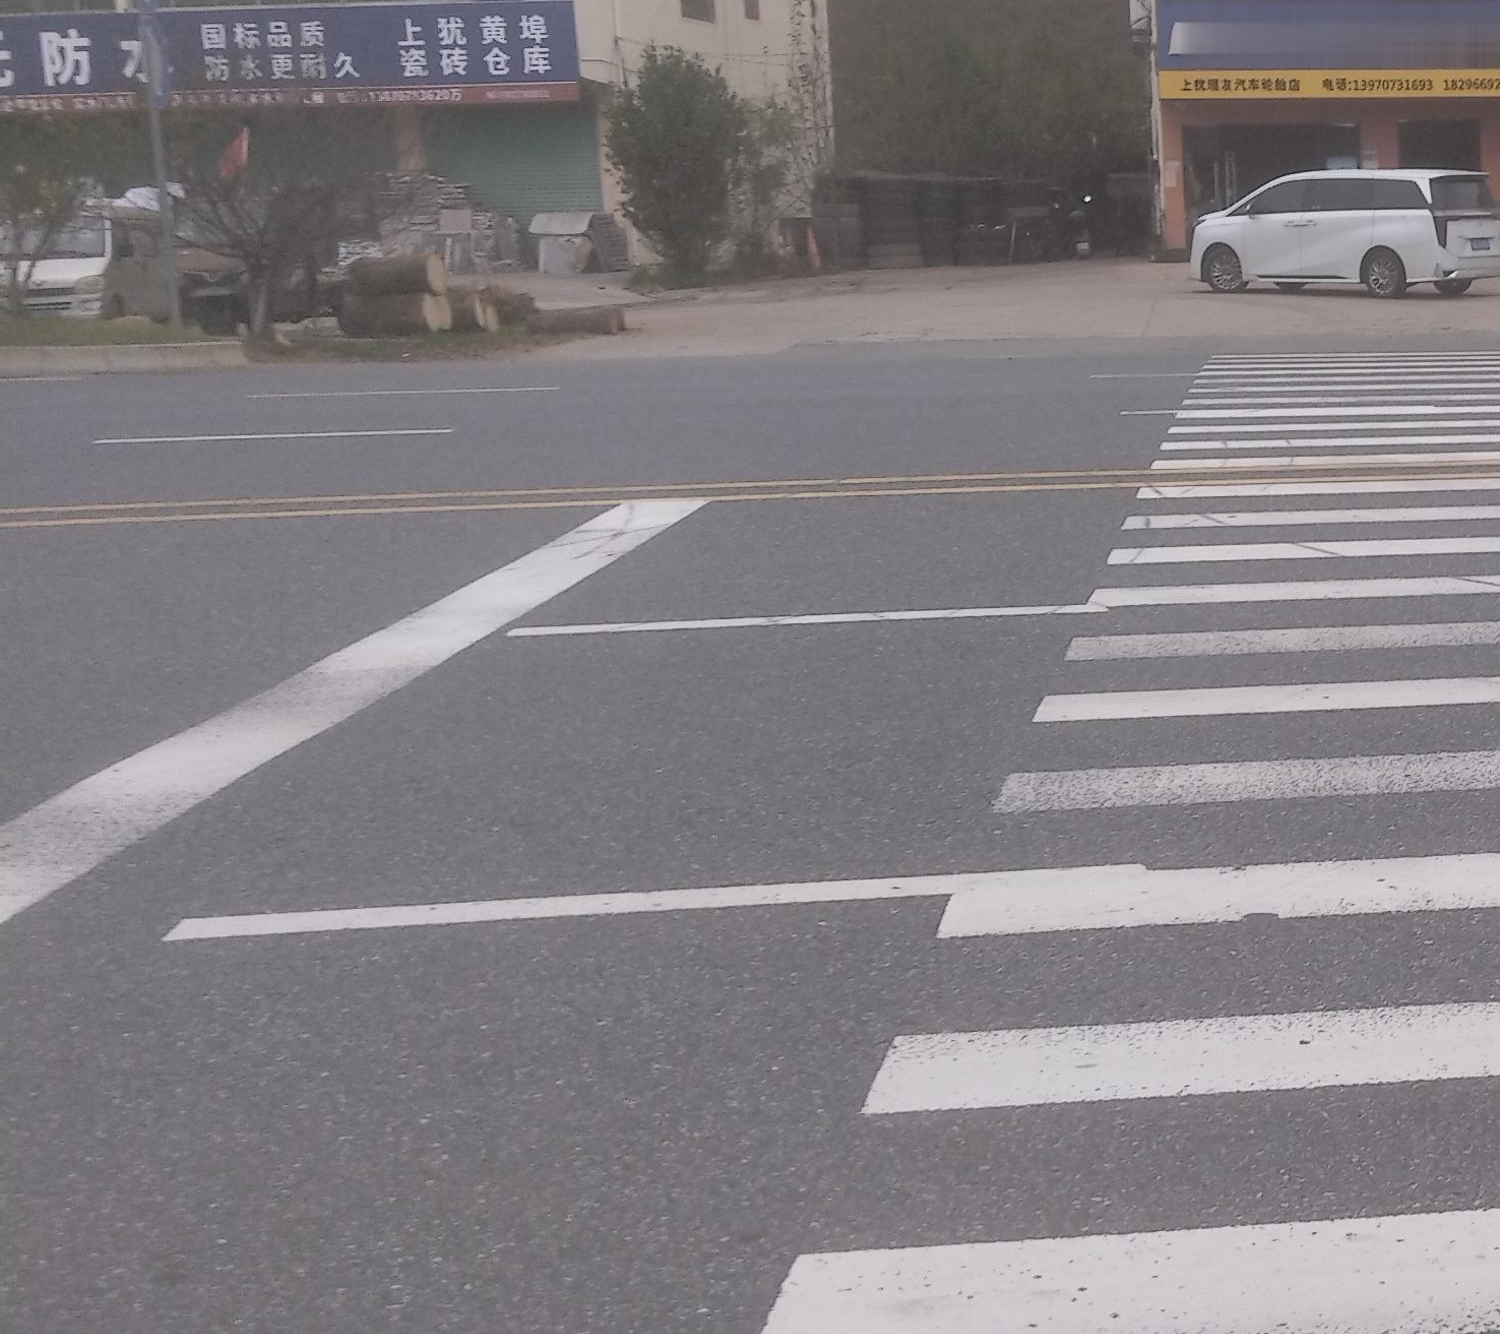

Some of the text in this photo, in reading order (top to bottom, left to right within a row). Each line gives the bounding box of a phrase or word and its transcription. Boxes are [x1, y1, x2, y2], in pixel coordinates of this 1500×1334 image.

[201, 20, 325, 50] 国标品质
[397, 14, 549, 47] 上犹黄埠
[203, 51, 360, 82] 防水更耐久
[399, 45, 552, 77] 瓷砖仓库
